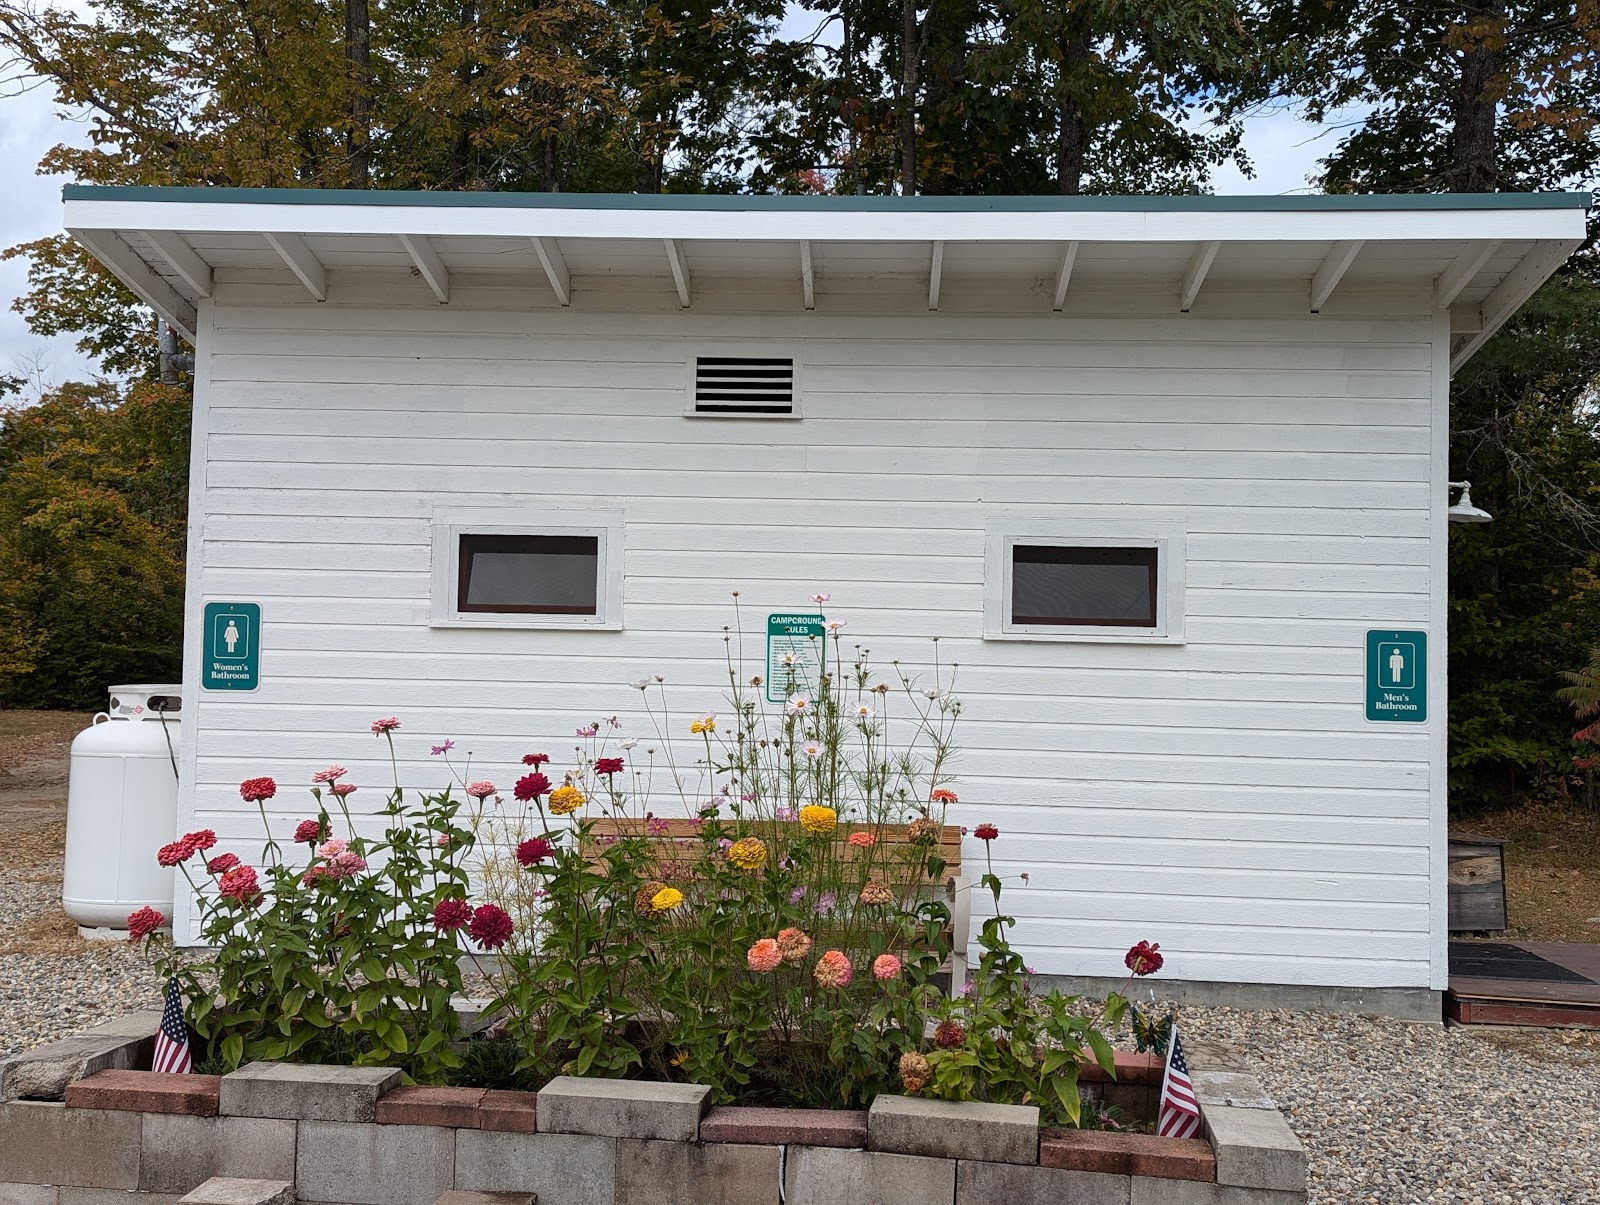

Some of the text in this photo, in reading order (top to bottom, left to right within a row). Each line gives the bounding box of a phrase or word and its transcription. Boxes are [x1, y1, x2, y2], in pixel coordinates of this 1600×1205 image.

[771, 616, 822, 625] CAMPGROUND
[212, 662, 248, 671] Women's
[211, 671, 250, 679] Bathroom
[1383, 693, 1409, 701] Men's
[1375, 702, 1417, 711] Bathroom
